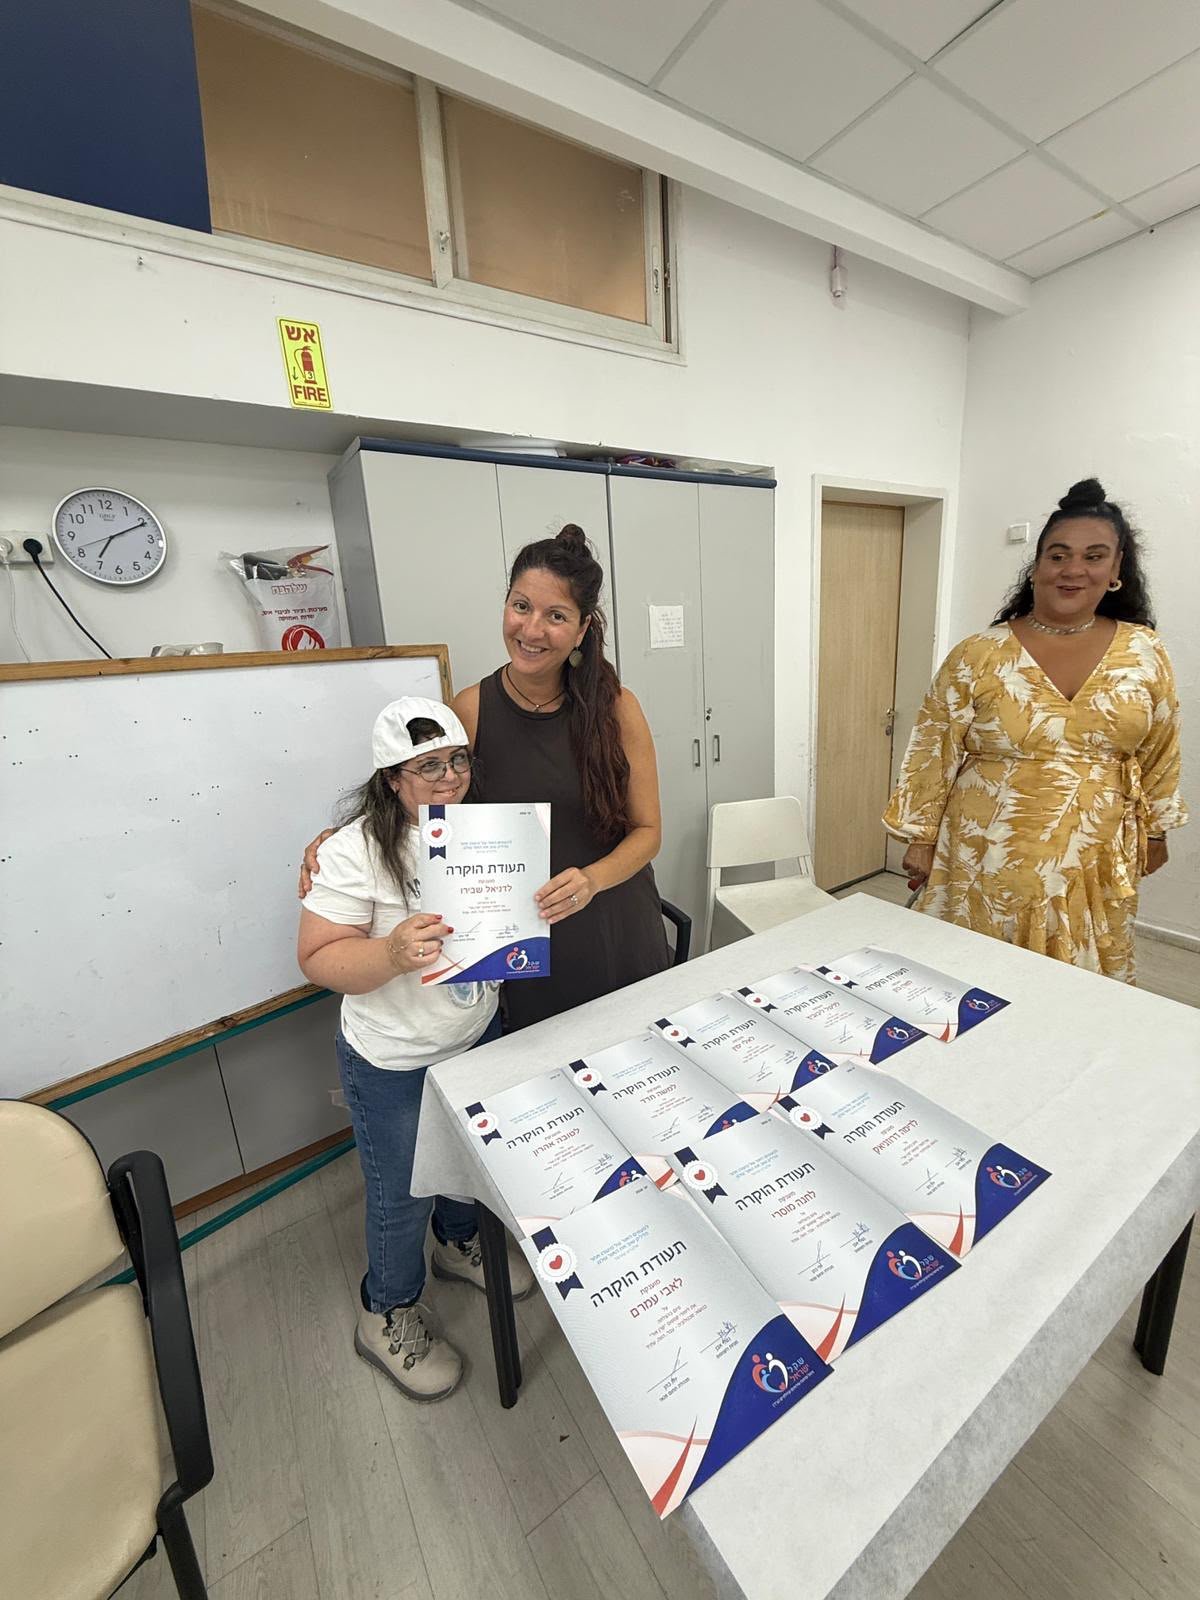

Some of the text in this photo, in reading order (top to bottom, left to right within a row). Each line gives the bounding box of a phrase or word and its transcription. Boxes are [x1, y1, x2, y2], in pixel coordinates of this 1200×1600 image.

[285, 325, 316, 344] אש
[293, 384, 327, 401] FIRE
[81, 504, 94, 514] 11
[98, 499, 113, 510] 12
[123, 506, 128, 516] 1
[69, 513, 85, 525] 10
[67, 531, 76, 541] 9
[147, 534, 155, 544] 3
[78, 547, 86, 558] 8
[144, 551, 152, 560] 4
[97, 560, 103, 570] 7
[115, 566, 123, 575] 6
[132, 561, 141, 571] 5
[446, 863, 525, 876] תעודת הוקרה
[808, 990, 834, 1003] תעודת
[783, 1001, 809, 1015] הוקרה
[729, 1019, 756, 1035] תעודת
[701, 1033, 729, 1049] הוקרה
[647, 1065, 679, 1083] תעודת
[612, 1081, 646, 1099] הוקרה
[547, 1107, 584, 1128] תעודת
[873, 1101, 905, 1123] תעודת
[506, 1126, 544, 1148] הוקרה
[843, 1120, 875, 1143] הוקרה
[532, 1127, 579, 1156] לטובה אהרון
[775, 1163, 815, 1188] תעודת
[735, 1184, 775, 1210] הוקרה
[771, 1190, 815, 1217] לחנה מוסרי
[640, 1241, 686, 1275] תעודת
[590, 1271, 638, 1306] הוקרה
[630, 1277, 682, 1317] לאבי עמרם
[789, 1363, 808, 1381] ישראל
